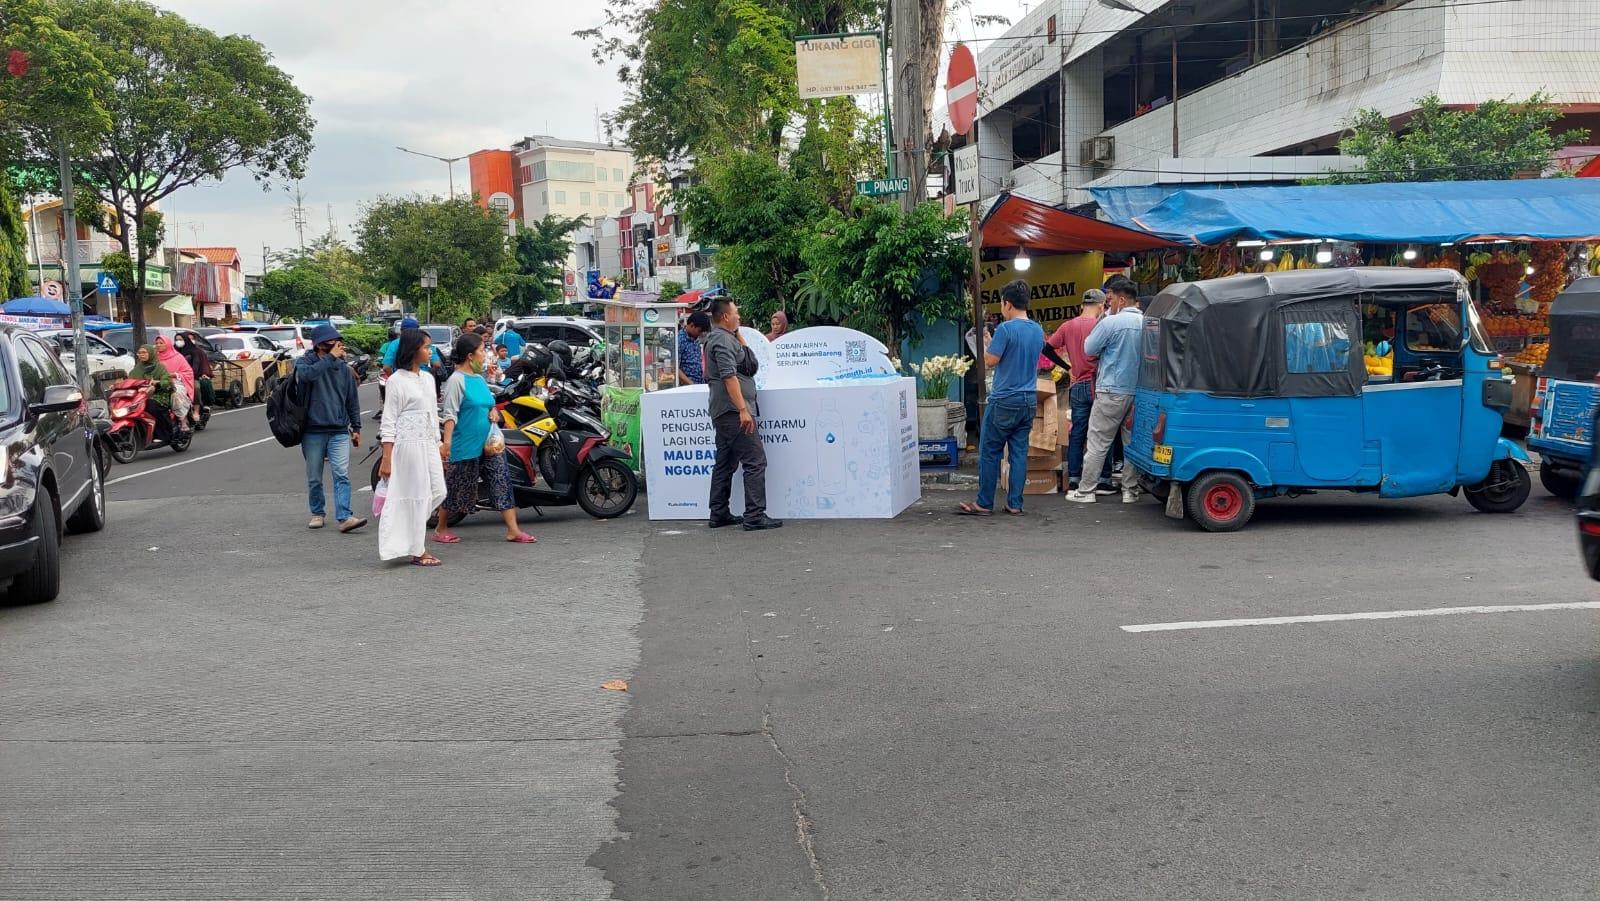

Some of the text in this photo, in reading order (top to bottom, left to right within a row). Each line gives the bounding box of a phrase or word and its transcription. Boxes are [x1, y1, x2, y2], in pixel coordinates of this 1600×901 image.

[800, 39, 876, 52] TUKANG GIGI
[874, 179, 908, 193] PINANG
[959, 175, 975, 194] Truck
[1030, 282, 1077, 300] AYAM
[803, 341, 828, 349] AIRNYA
[792, 350, 842, 358] #LakuinBareng
[661, 408, 711, 419] RATUSAN
[663, 437, 687, 447] LAGI
[690, 436, 717, 446] NGE
[664, 450, 693, 461] MAU
